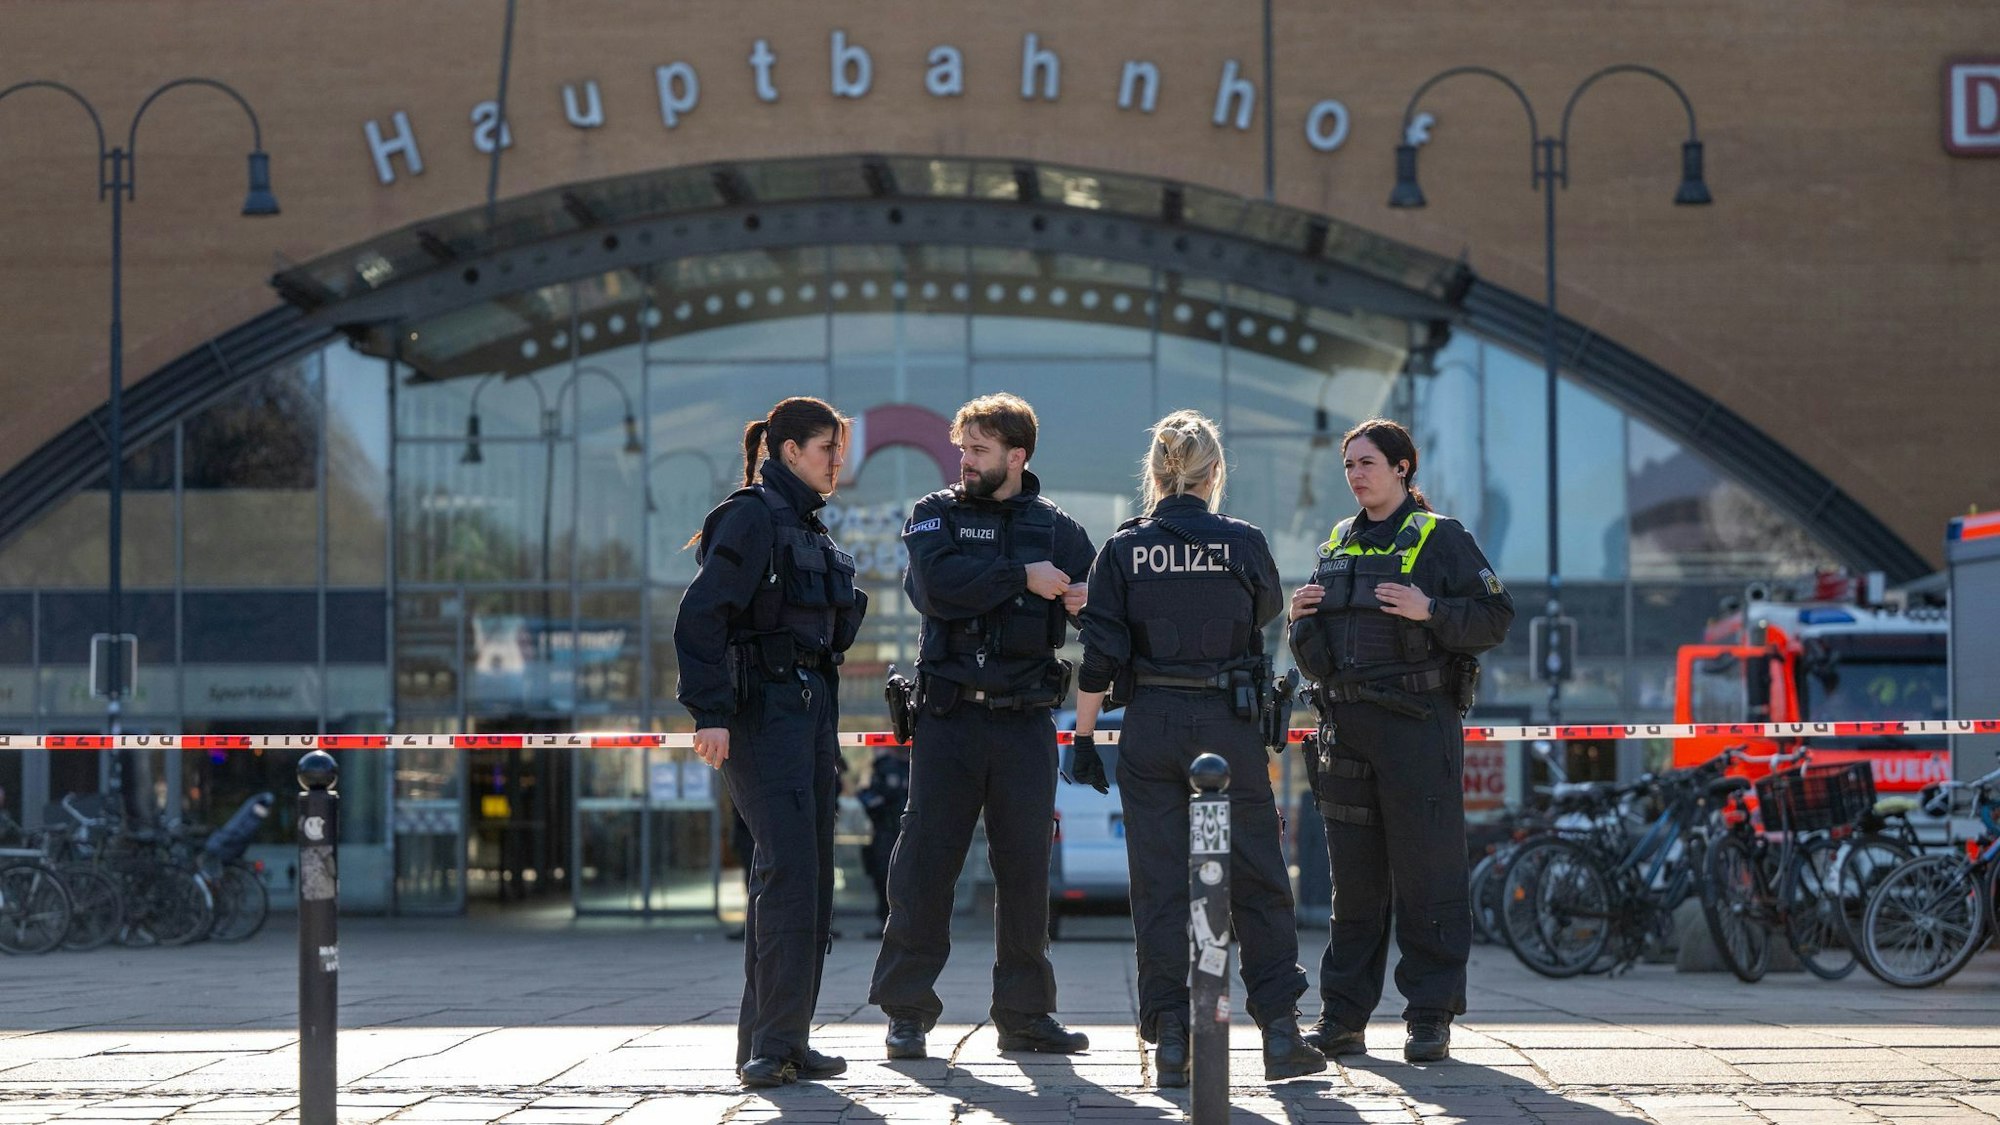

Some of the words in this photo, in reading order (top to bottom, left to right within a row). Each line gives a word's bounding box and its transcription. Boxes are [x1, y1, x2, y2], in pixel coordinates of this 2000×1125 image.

[364, 29, 1435, 184] Hauptbahnhof
[960, 528, 994, 540] POLIZEI
[1132, 543, 1230, 575] POLIZEI
[1320, 558, 1349, 572] POLIZEI
[209, 683, 294, 701] Sportsbar
